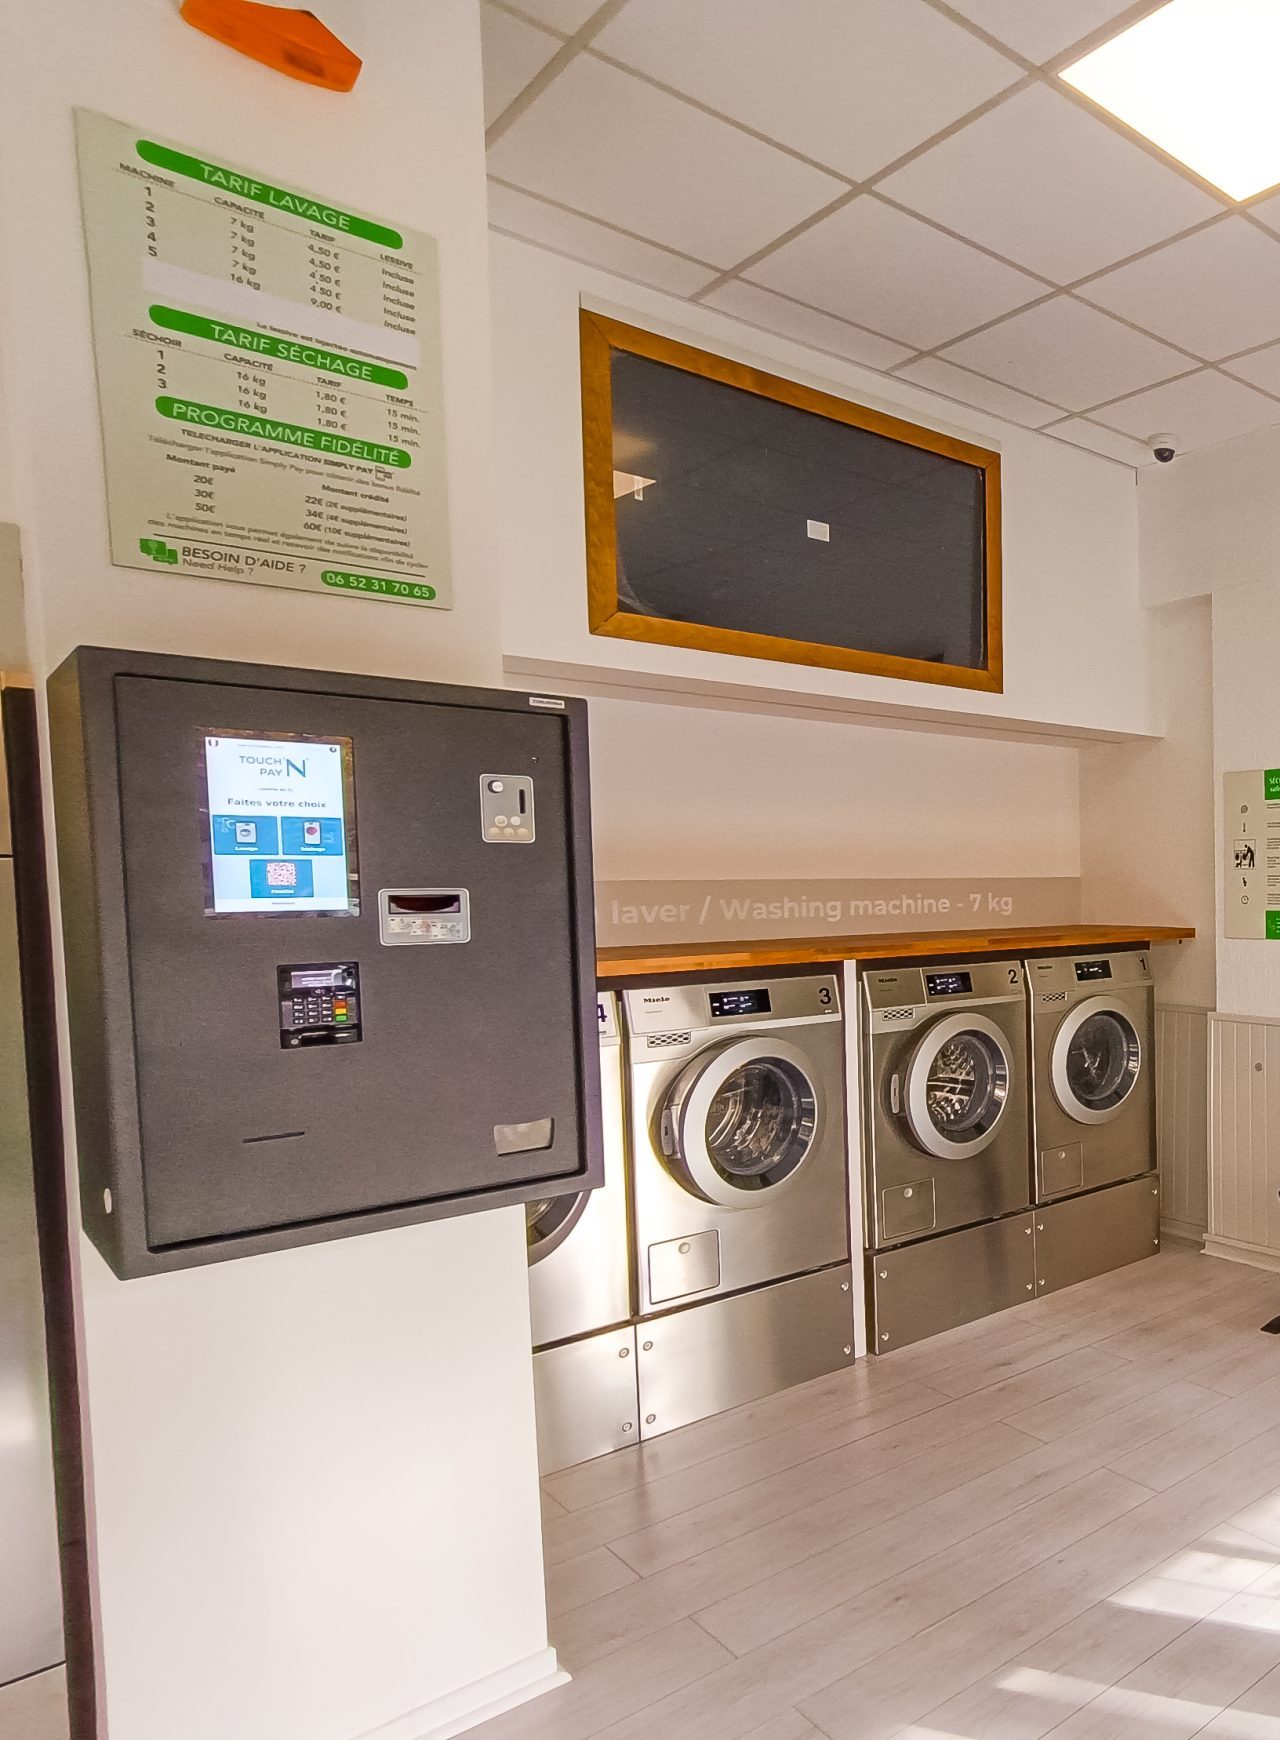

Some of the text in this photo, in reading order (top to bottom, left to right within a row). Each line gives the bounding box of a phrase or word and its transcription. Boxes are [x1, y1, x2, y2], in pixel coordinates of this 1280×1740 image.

[120, 163, 175, 188] MACHINE
[145, 186, 151, 196] 1
[200, 164, 350, 230] TARIF LAVAGE
[145, 201, 155, 213] 2
[146, 216, 155, 227] 3
[230, 217, 254, 233] 7 kg
[147, 232, 156, 241] 4
[230, 231, 255, 247] 7 kg
[310, 229, 335, 242] TARIF
[148, 245, 157, 257] 5
[231, 245, 256, 261] 7 kg
[334, 252, 340, 260] €
[380, 253, 414, 269] LESSIVE
[242, 263, 257, 275] kg
[334, 266, 340, 274] €
[230, 273, 261, 290] 16 kg
[335, 279, 341, 287] €
[382, 268, 415, 285] Incluse
[382, 281, 415, 297] Incluse
[335, 293, 342, 301] €
[383, 294, 415, 310] Incluse
[335, 306, 342, 314] €
[383, 307, 416, 323] Incluse
[384, 320, 416, 335] Incluse
[157, 350, 164, 360] 1
[210, 324, 270, 351] TARIF
[277, 345, 372, 380] SÉCHAGE
[224, 353, 273, 371] CAPACITÉ
[157, 364, 166, 375] 2
[158, 378, 167, 389] 3
[236, 371, 266, 387] 16 kg
[316, 376, 342, 388] TARIF
[238, 385, 267, 401] 16 kg
[238, 399, 268, 415] 16 kg
[340, 397, 346, 405] €
[386, 394, 414, 407] TEMPS
[340, 410, 347, 418] €
[387, 408, 420, 423] 15 min.
[173, 403, 400, 465] PROGRAMME FIDÉLITÉ
[341, 423, 347, 431] €
[388, 421, 421, 435] 15 min.
[388, 434, 421, 448] 15 min.
[166, 453, 236, 474] Montant payé
[253, 444, 322, 464] L'APPLICATION
[323, 458, 355, 471] SIMPLY
[356, 465, 374, 475] PAY
[193, 475, 214, 485] 20€
[193, 489, 214, 499] 30€
[305, 495, 323, 506] 22€
[321, 484, 390, 504] Montant crédité
[194, 503, 216, 514] 50€
[305, 509, 324, 519] 34€
[303, 522, 322, 533] 60€
[182, 546, 307, 574] BESOIN D'AIDE ?
[182, 558, 254, 576] Need Help ?
[326, 573, 430, 598] 06 52 31 70 65
[239, 755, 307, 778] TOUCH N
[260, 768, 283, 777] PAY
[227, 798, 263, 807] Faites
[266, 800, 295, 808] votre
[611, 899, 690, 925] laver
[699, 894, 713, 926] /
[723, 896, 842, 923] Washing
[850, 893, 950, 917] machine
[970, 894, 981, 912] 7
[988, 893, 1013, 916] kg
[1138, 957, 1146, 971] 1
[1008, 969, 1019, 985] 2
[643, 996, 670, 1004] Miele
[818, 987, 832, 1005] 3
[597, 1003, 607, 1023] 4
